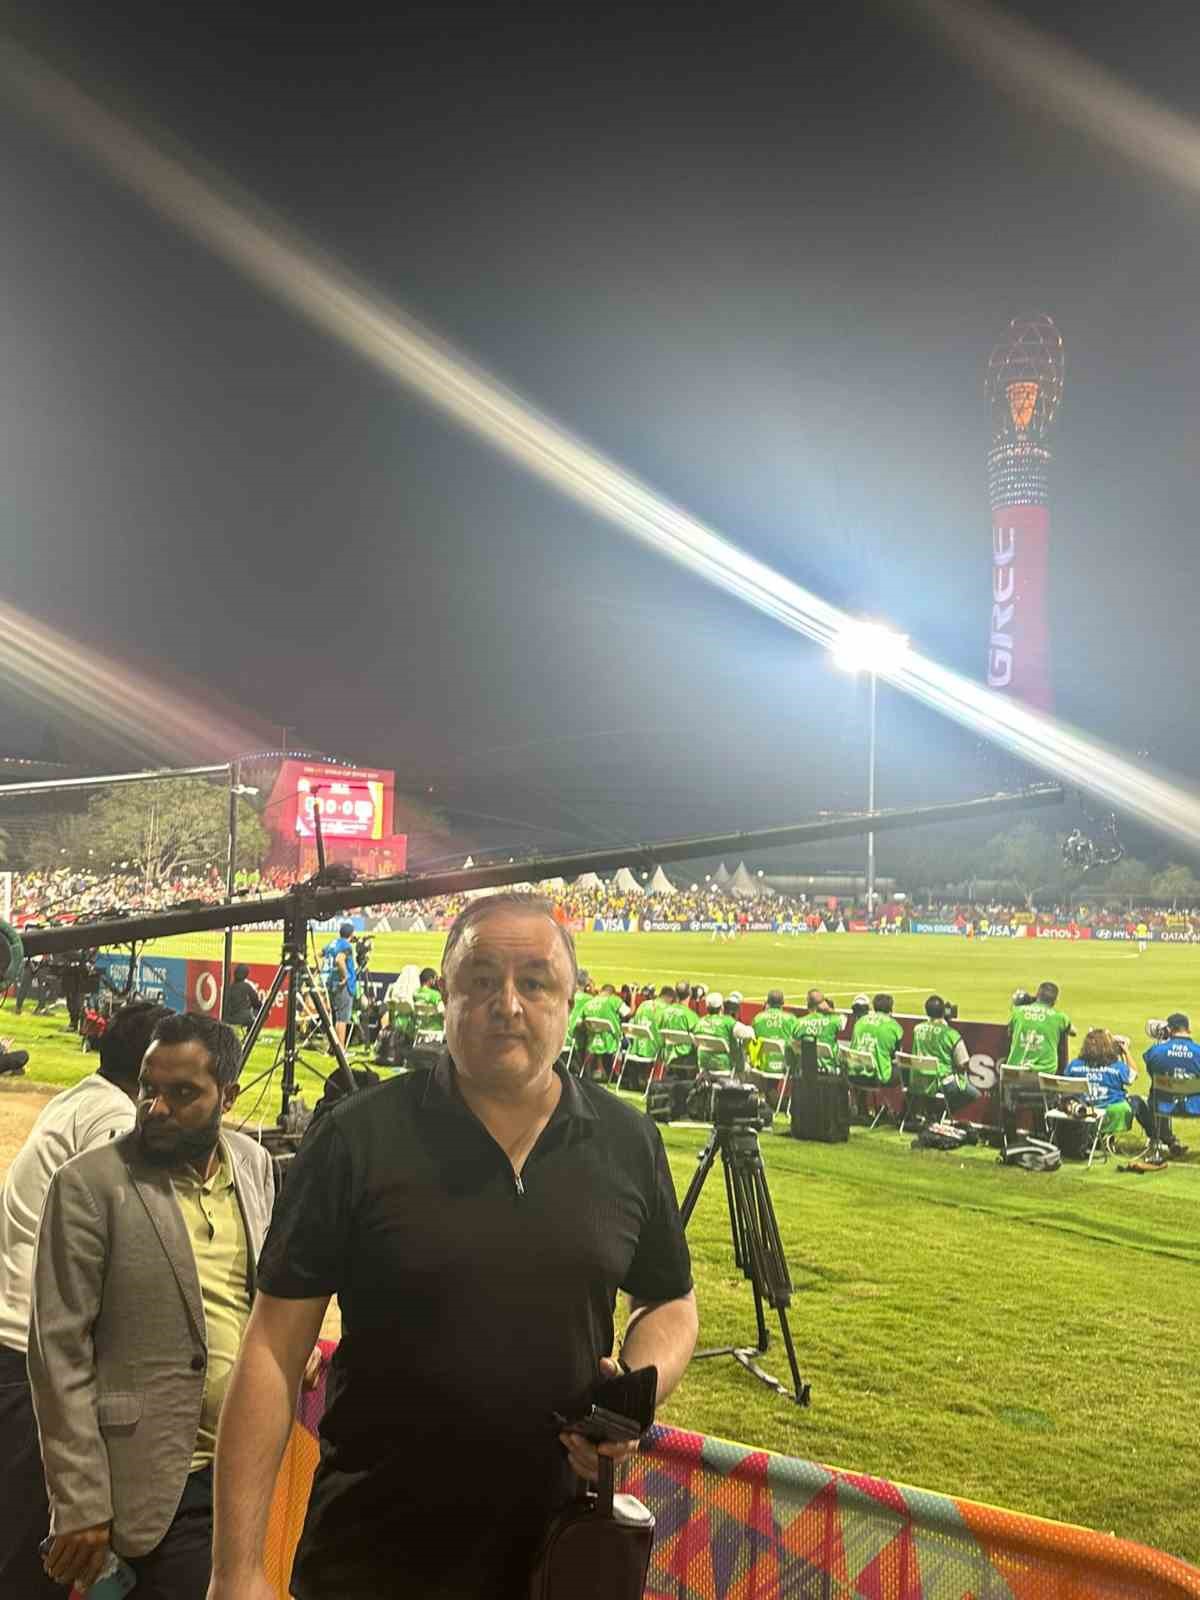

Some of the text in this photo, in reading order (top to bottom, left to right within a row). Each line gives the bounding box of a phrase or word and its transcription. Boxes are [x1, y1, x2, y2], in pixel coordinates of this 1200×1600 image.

[988, 526, 1016, 687] GREE
[602, 919, 625, 932] VISA
[987, 924, 1010, 936] VISA
[1172, 1043, 1188, 1052] FIFA
[1167, 1049, 1193, 1059] PHOTO
